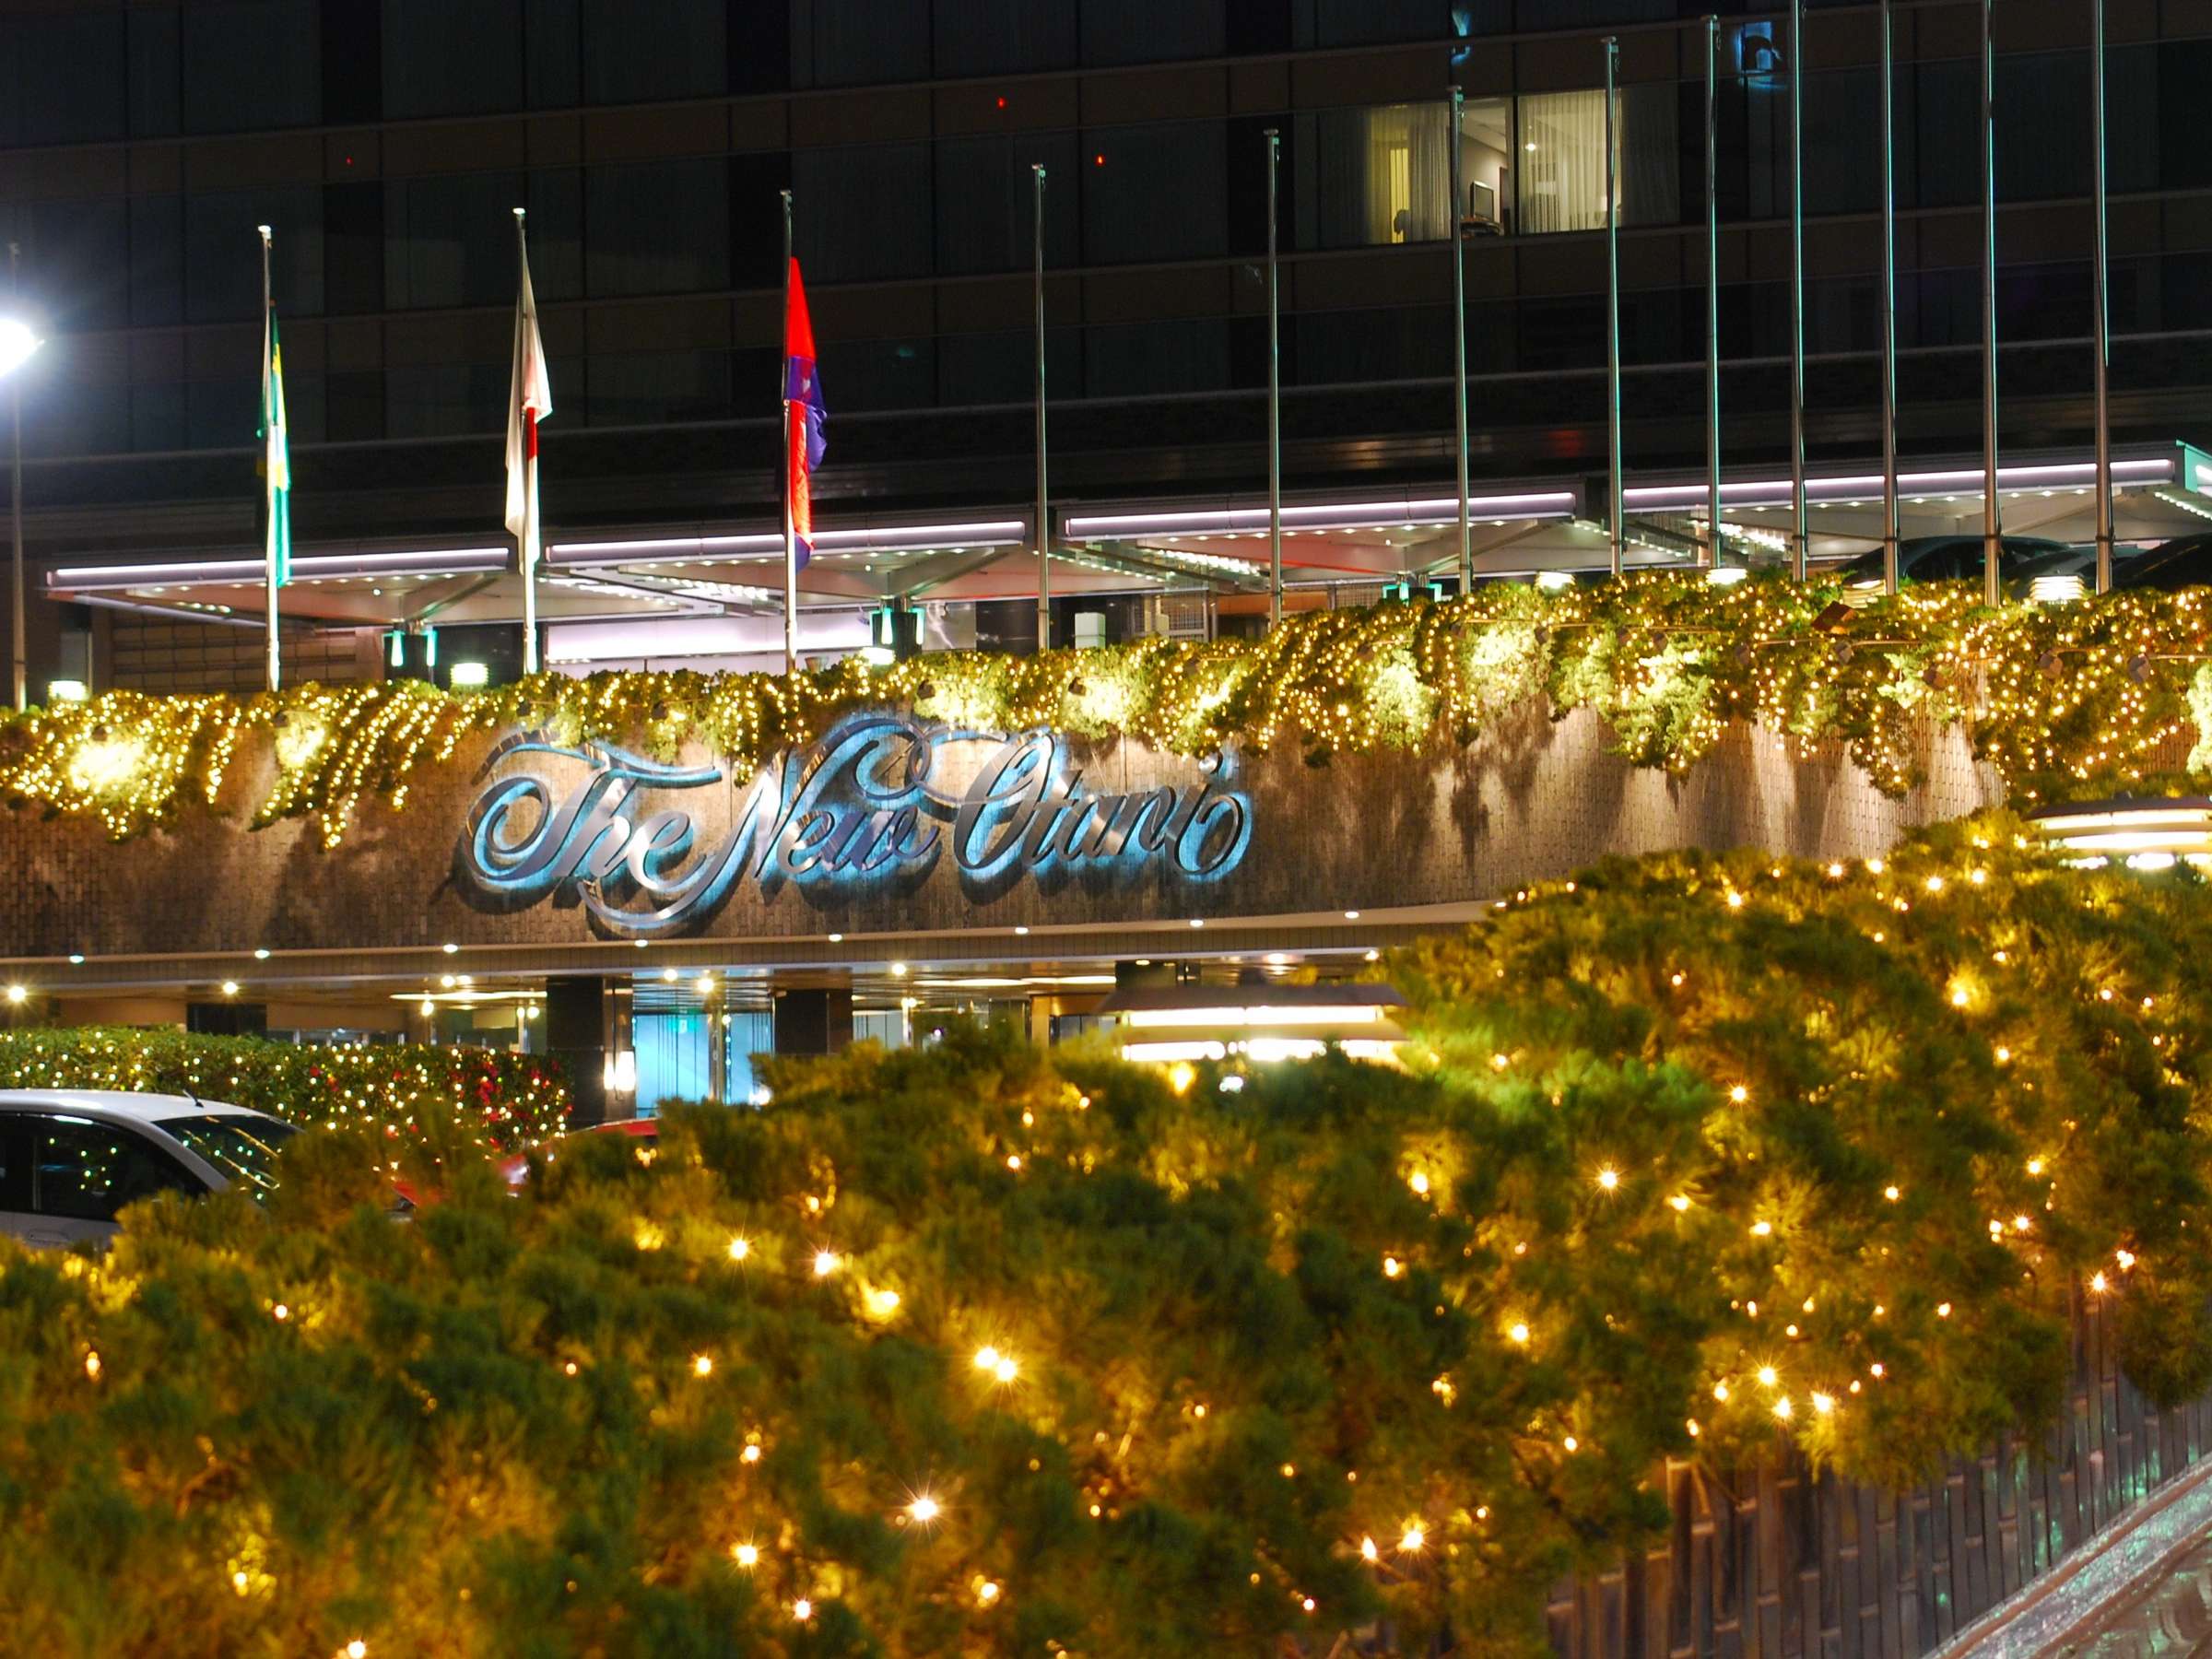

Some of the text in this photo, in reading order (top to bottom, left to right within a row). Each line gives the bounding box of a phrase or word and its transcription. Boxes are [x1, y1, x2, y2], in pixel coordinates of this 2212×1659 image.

[462, 718, 1243, 929] The New Otani
